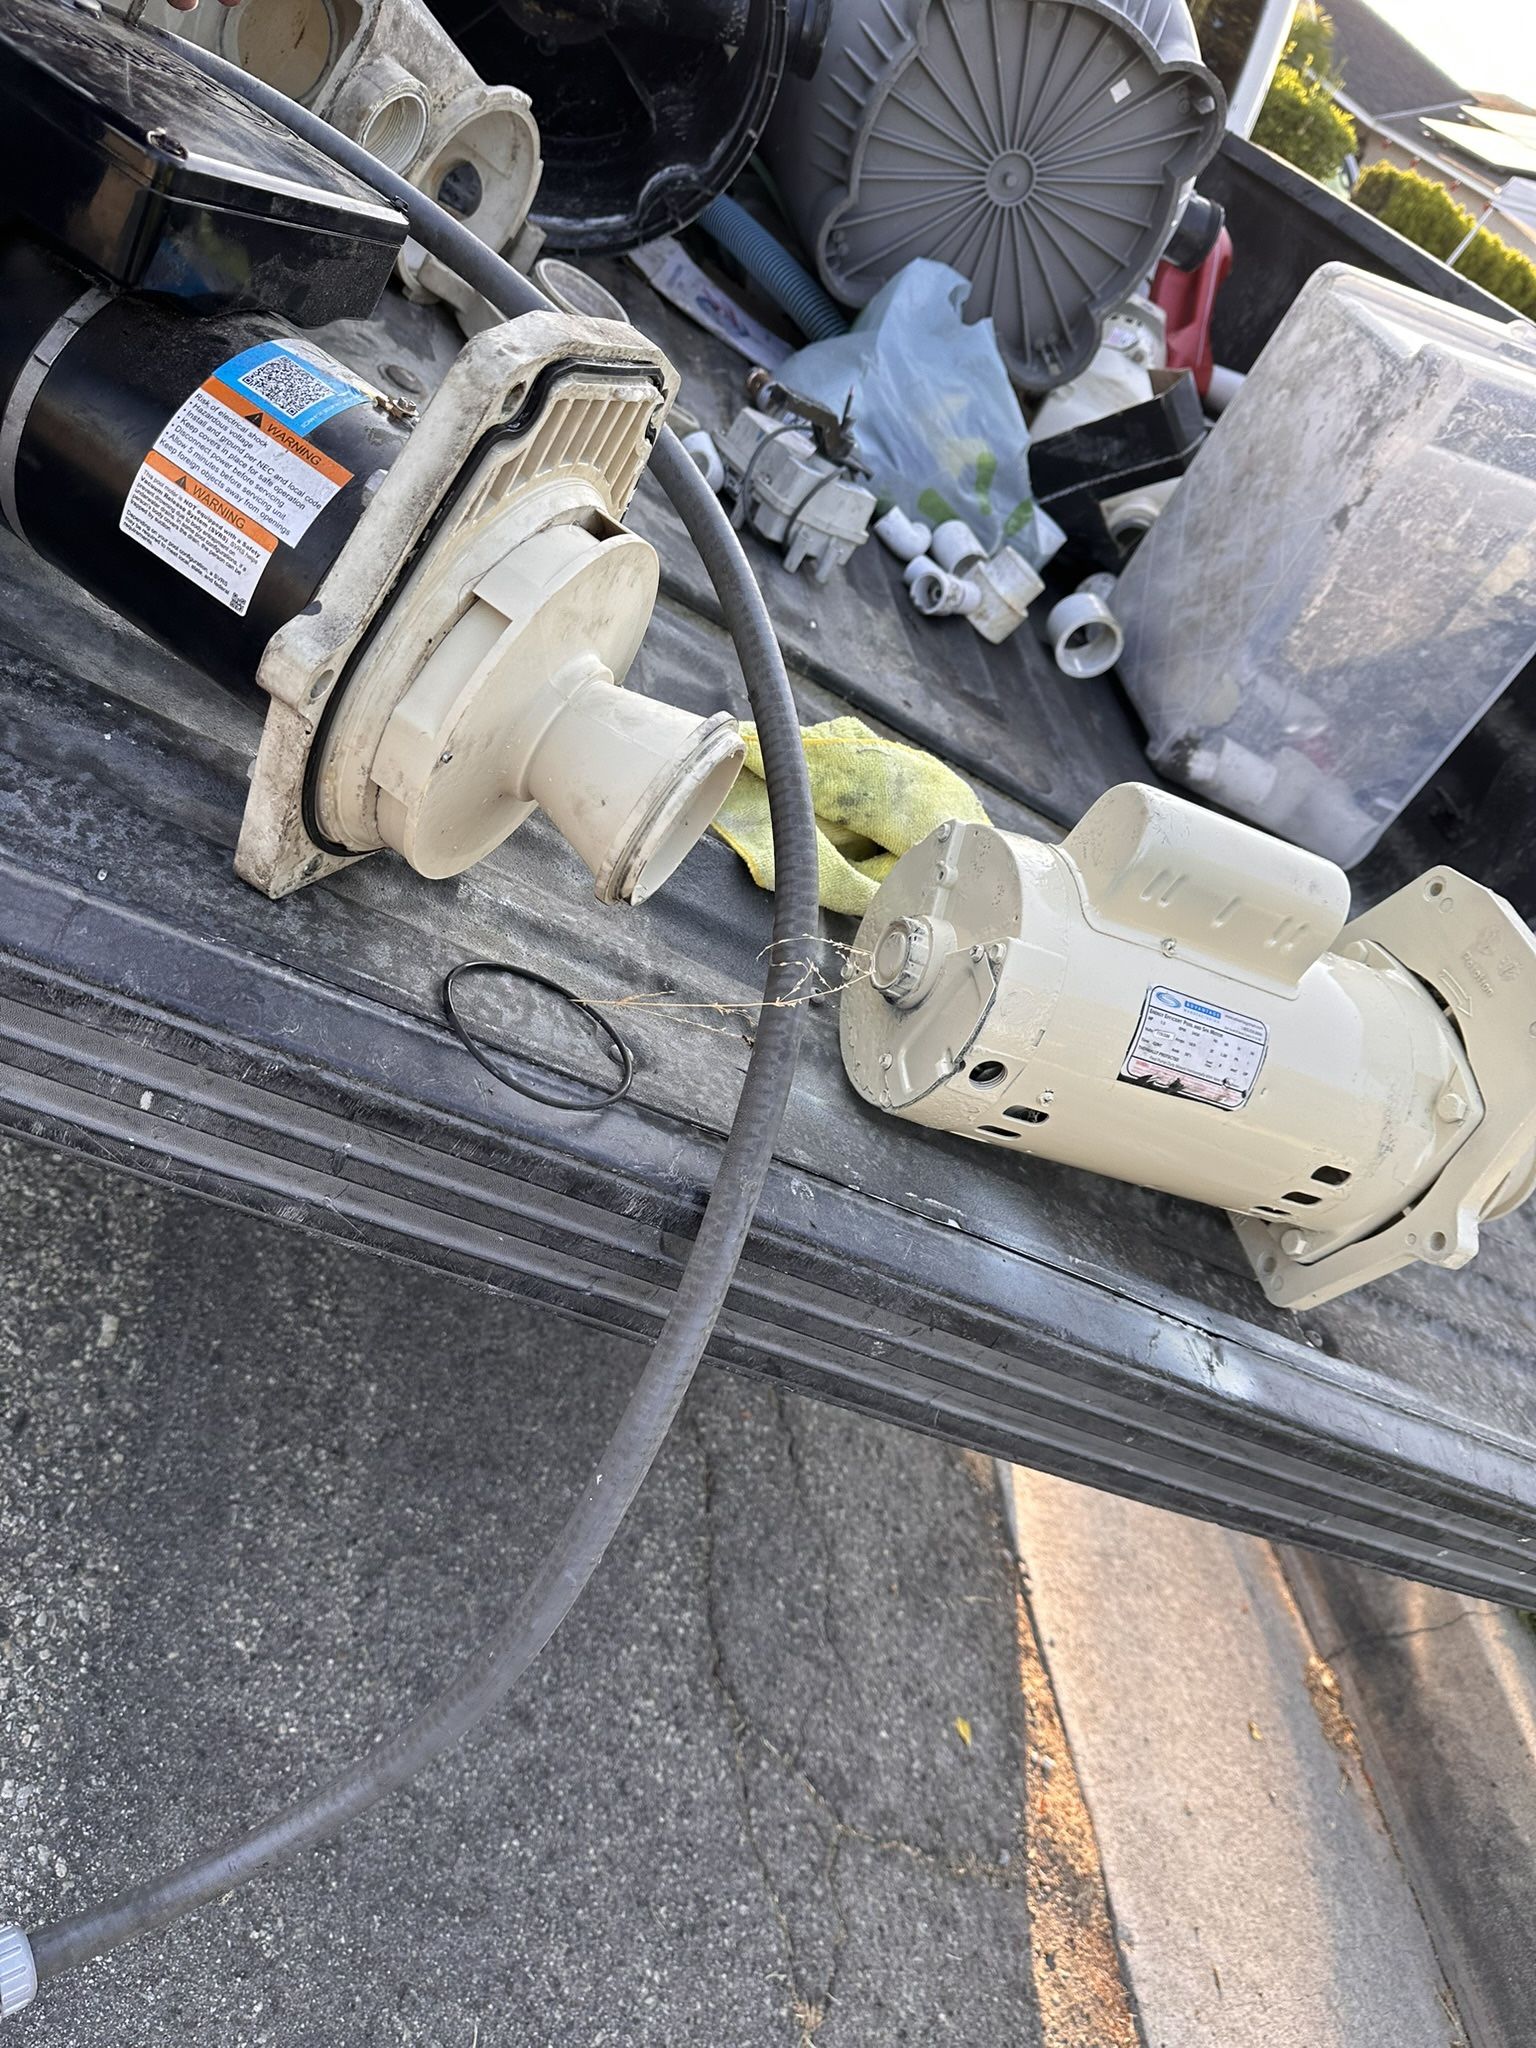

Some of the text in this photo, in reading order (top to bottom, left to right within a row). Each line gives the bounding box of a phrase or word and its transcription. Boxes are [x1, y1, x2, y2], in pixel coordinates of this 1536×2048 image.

[193, 404, 254, 449] Hazardous voltage
[195, 393, 210, 407] Risk
[218, 411, 249, 434] electrical
[248, 431, 268, 448] shock
[268, 424, 322, 466] WARNING
[159, 438, 290, 536] Keep foreign objects away from openings
[169, 433, 188, 450] Allow
[193, 451, 220, 473] minutes
[219, 470, 242, 489] before
[242, 487, 272, 511] servicing
[273, 508, 287, 520] unit
[174, 425, 285, 508] Disconnect power before servicing
[180, 418, 306, 510] Keep covers in place for safe operation
[187, 411, 208, 429] Install
[207, 425, 221, 437] and
[244, 453, 257, 464] per
[257, 460, 274, 475] NEC
[274, 472, 289, 485] and
[288, 483, 306, 497] local
[305, 496, 322, 509] code
[130, 500, 148, 514] trapped
[135, 489, 160, 507] underwater
[181, 523, 195, 534] some
[195, 532, 206, 543] pool
[137, 482, 155, 498] prevent
[155, 496, 176, 514] drowning
[176, 510, 185, 519] due
[191, 521, 203, 532] body
[202, 530, 229, 551] entrapment
[140, 476, 163, 496] Vacuum
[164, 493, 186, 512] Release
[187, 509, 208, 528] System
[230, 542, 246, 555] SVRS
[245, 552, 258, 565] helps
[144, 470, 154, 481] This
[153, 478, 164, 487] pool
[164, 486, 178, 497] motor
[184, 499, 196, 510] NOT
[197, 509, 223, 530] equipped
[223, 528, 237, 540] with
[242, 542, 261, 558] Safety
[151, 506, 164, 519] body
[164, 516, 179, 530] covers
[179, 527, 187, 536] the
[201, 544, 209, 552] the
[208, 549, 226, 565] person
[226, 562, 235, 572] can
[235, 568, 242, 576] be
[192, 484, 246, 530] WARNING
[125, 516, 135, 526] may
[142, 529, 161, 544] required
[166, 547, 179, 557] meet
[204, 574, 214, 583] and
[214, 580, 230, 595] federal
[126, 510, 151, 531] Depending
[157, 534, 168, 543] your
[168, 541, 179, 551] pool
[214, 574, 228, 586] SVRS
[1185, 1002, 1220, 1018] ADVANTAGE
